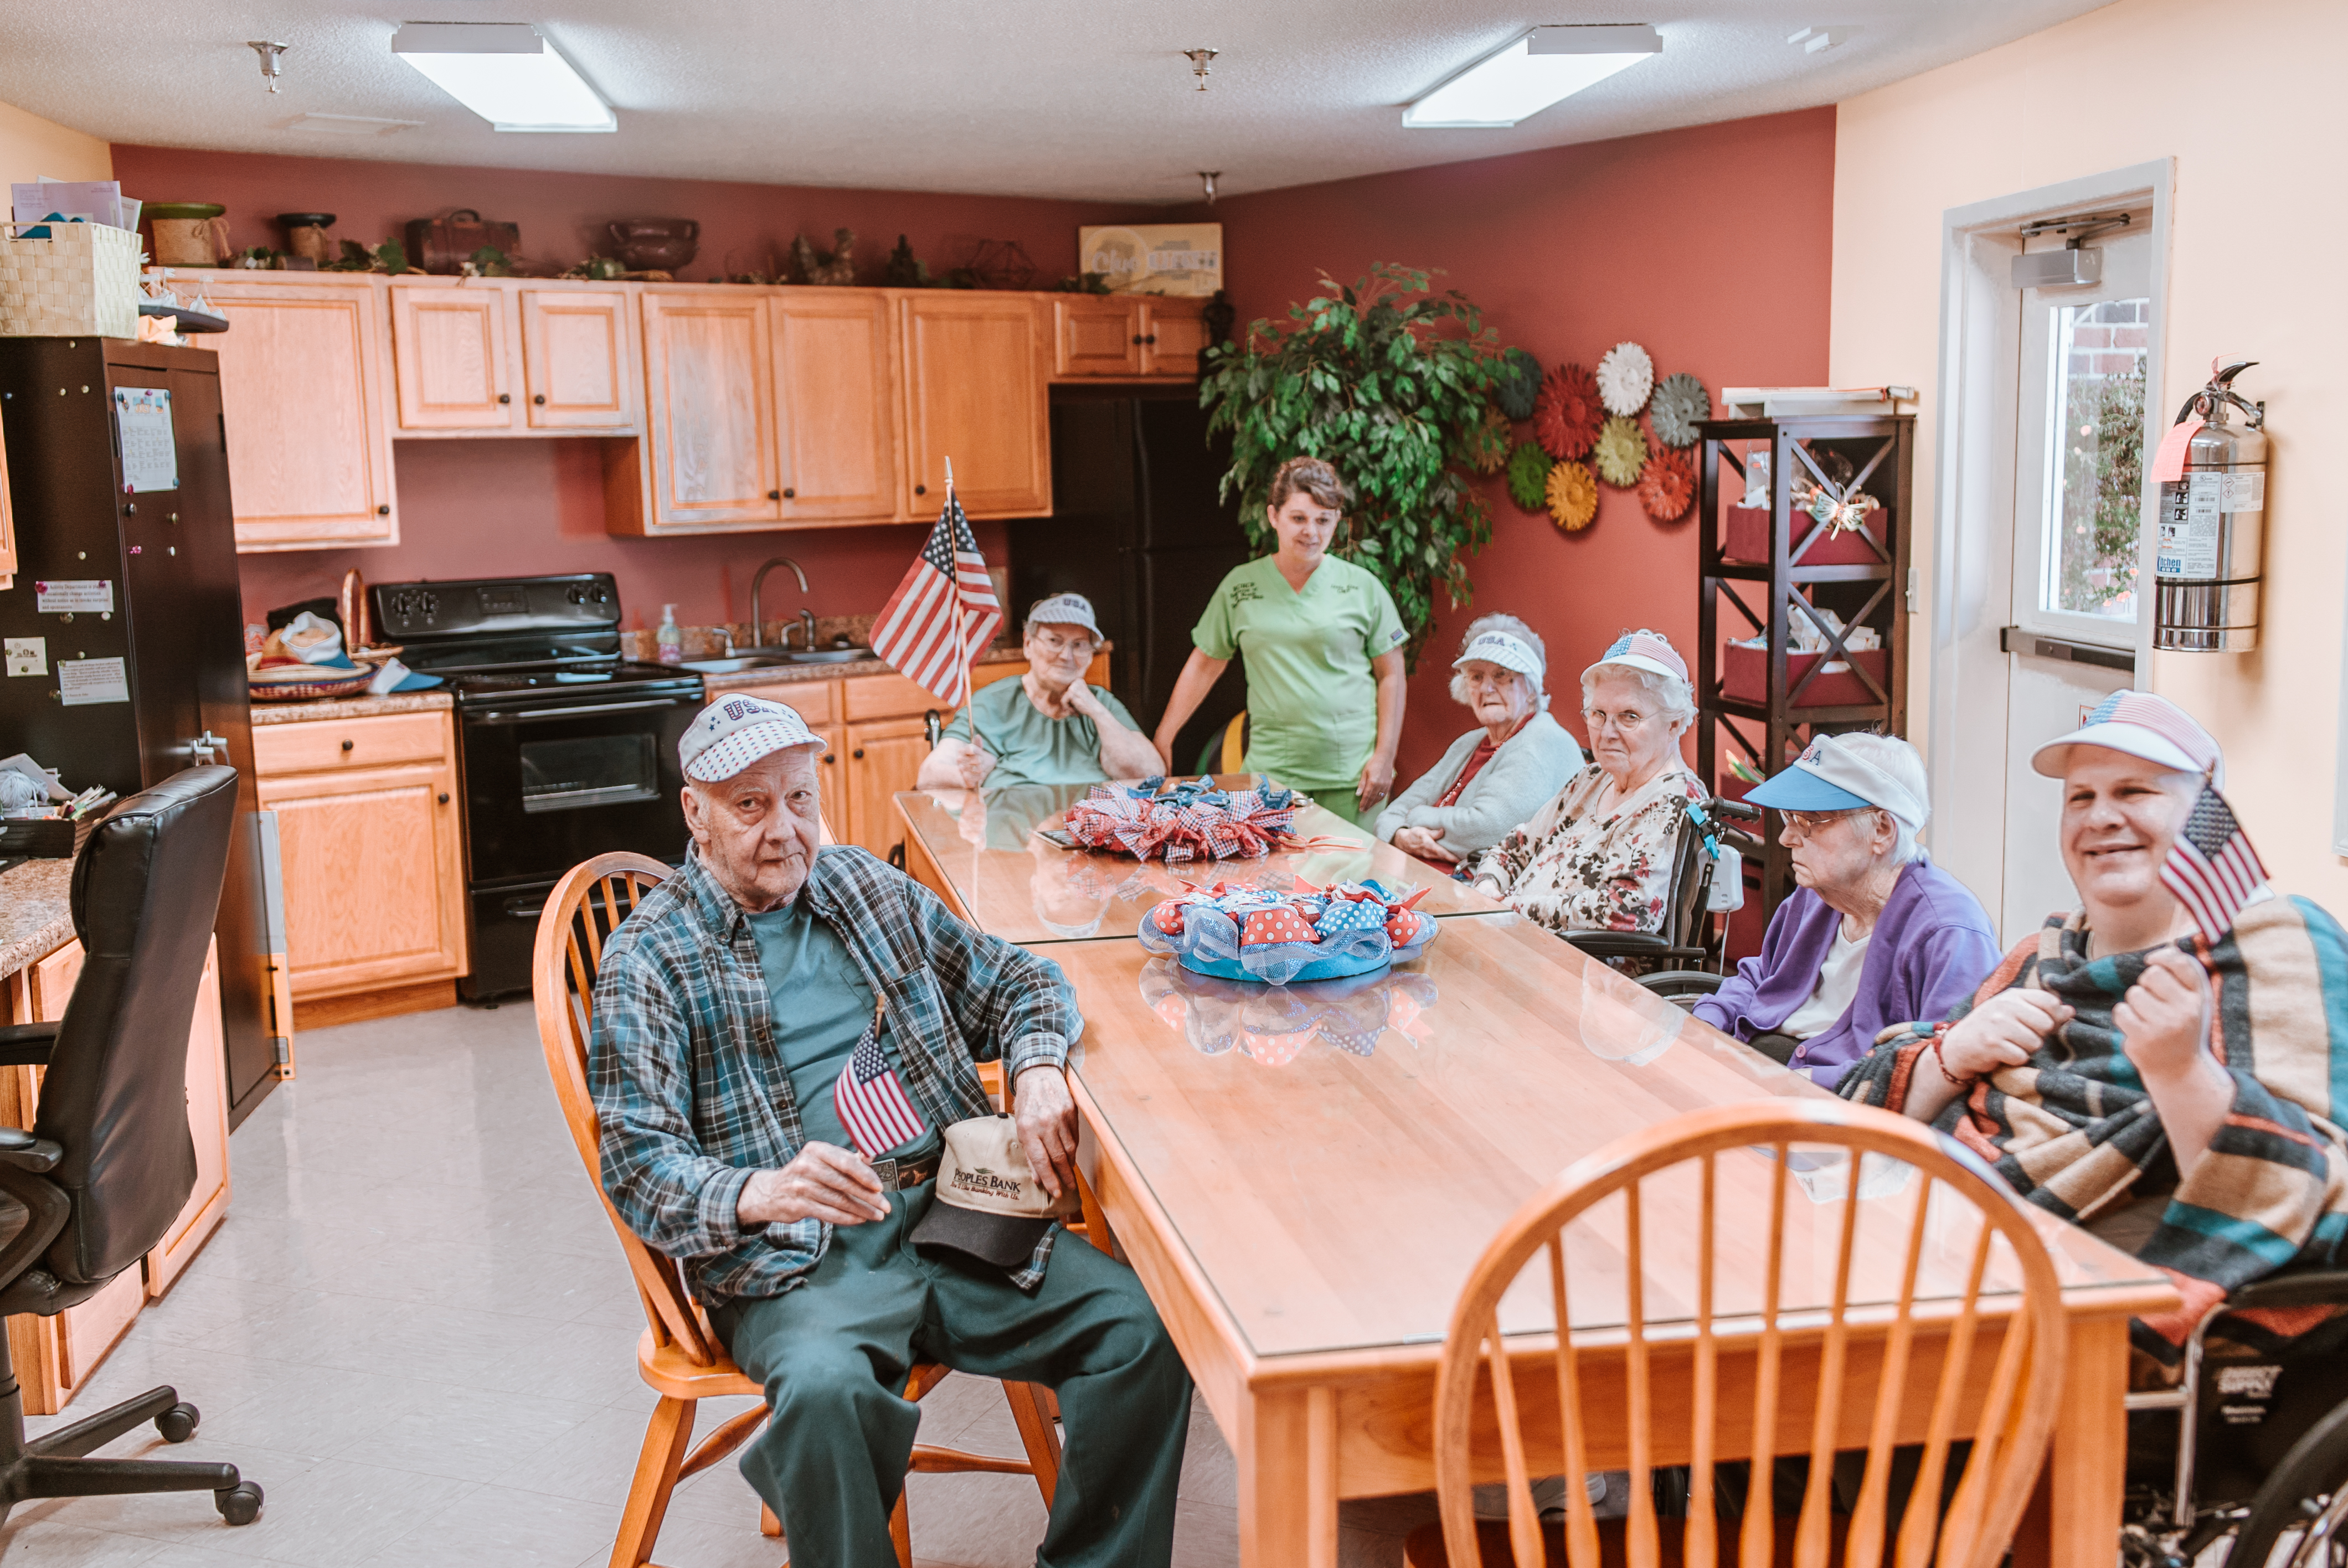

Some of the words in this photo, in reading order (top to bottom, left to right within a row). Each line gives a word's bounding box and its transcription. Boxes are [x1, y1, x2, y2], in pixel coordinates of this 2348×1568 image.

[1091, 249, 1141, 275] Clue
[1477, 635, 1505, 646] USA
[1802, 744, 1822, 767] SA
[954, 1168, 988, 1186] PEOPLES
[990, 1175, 1021, 1193] BANK
[971, 1186, 994, 1196] Banking
[996, 1190, 1009, 1198] With
